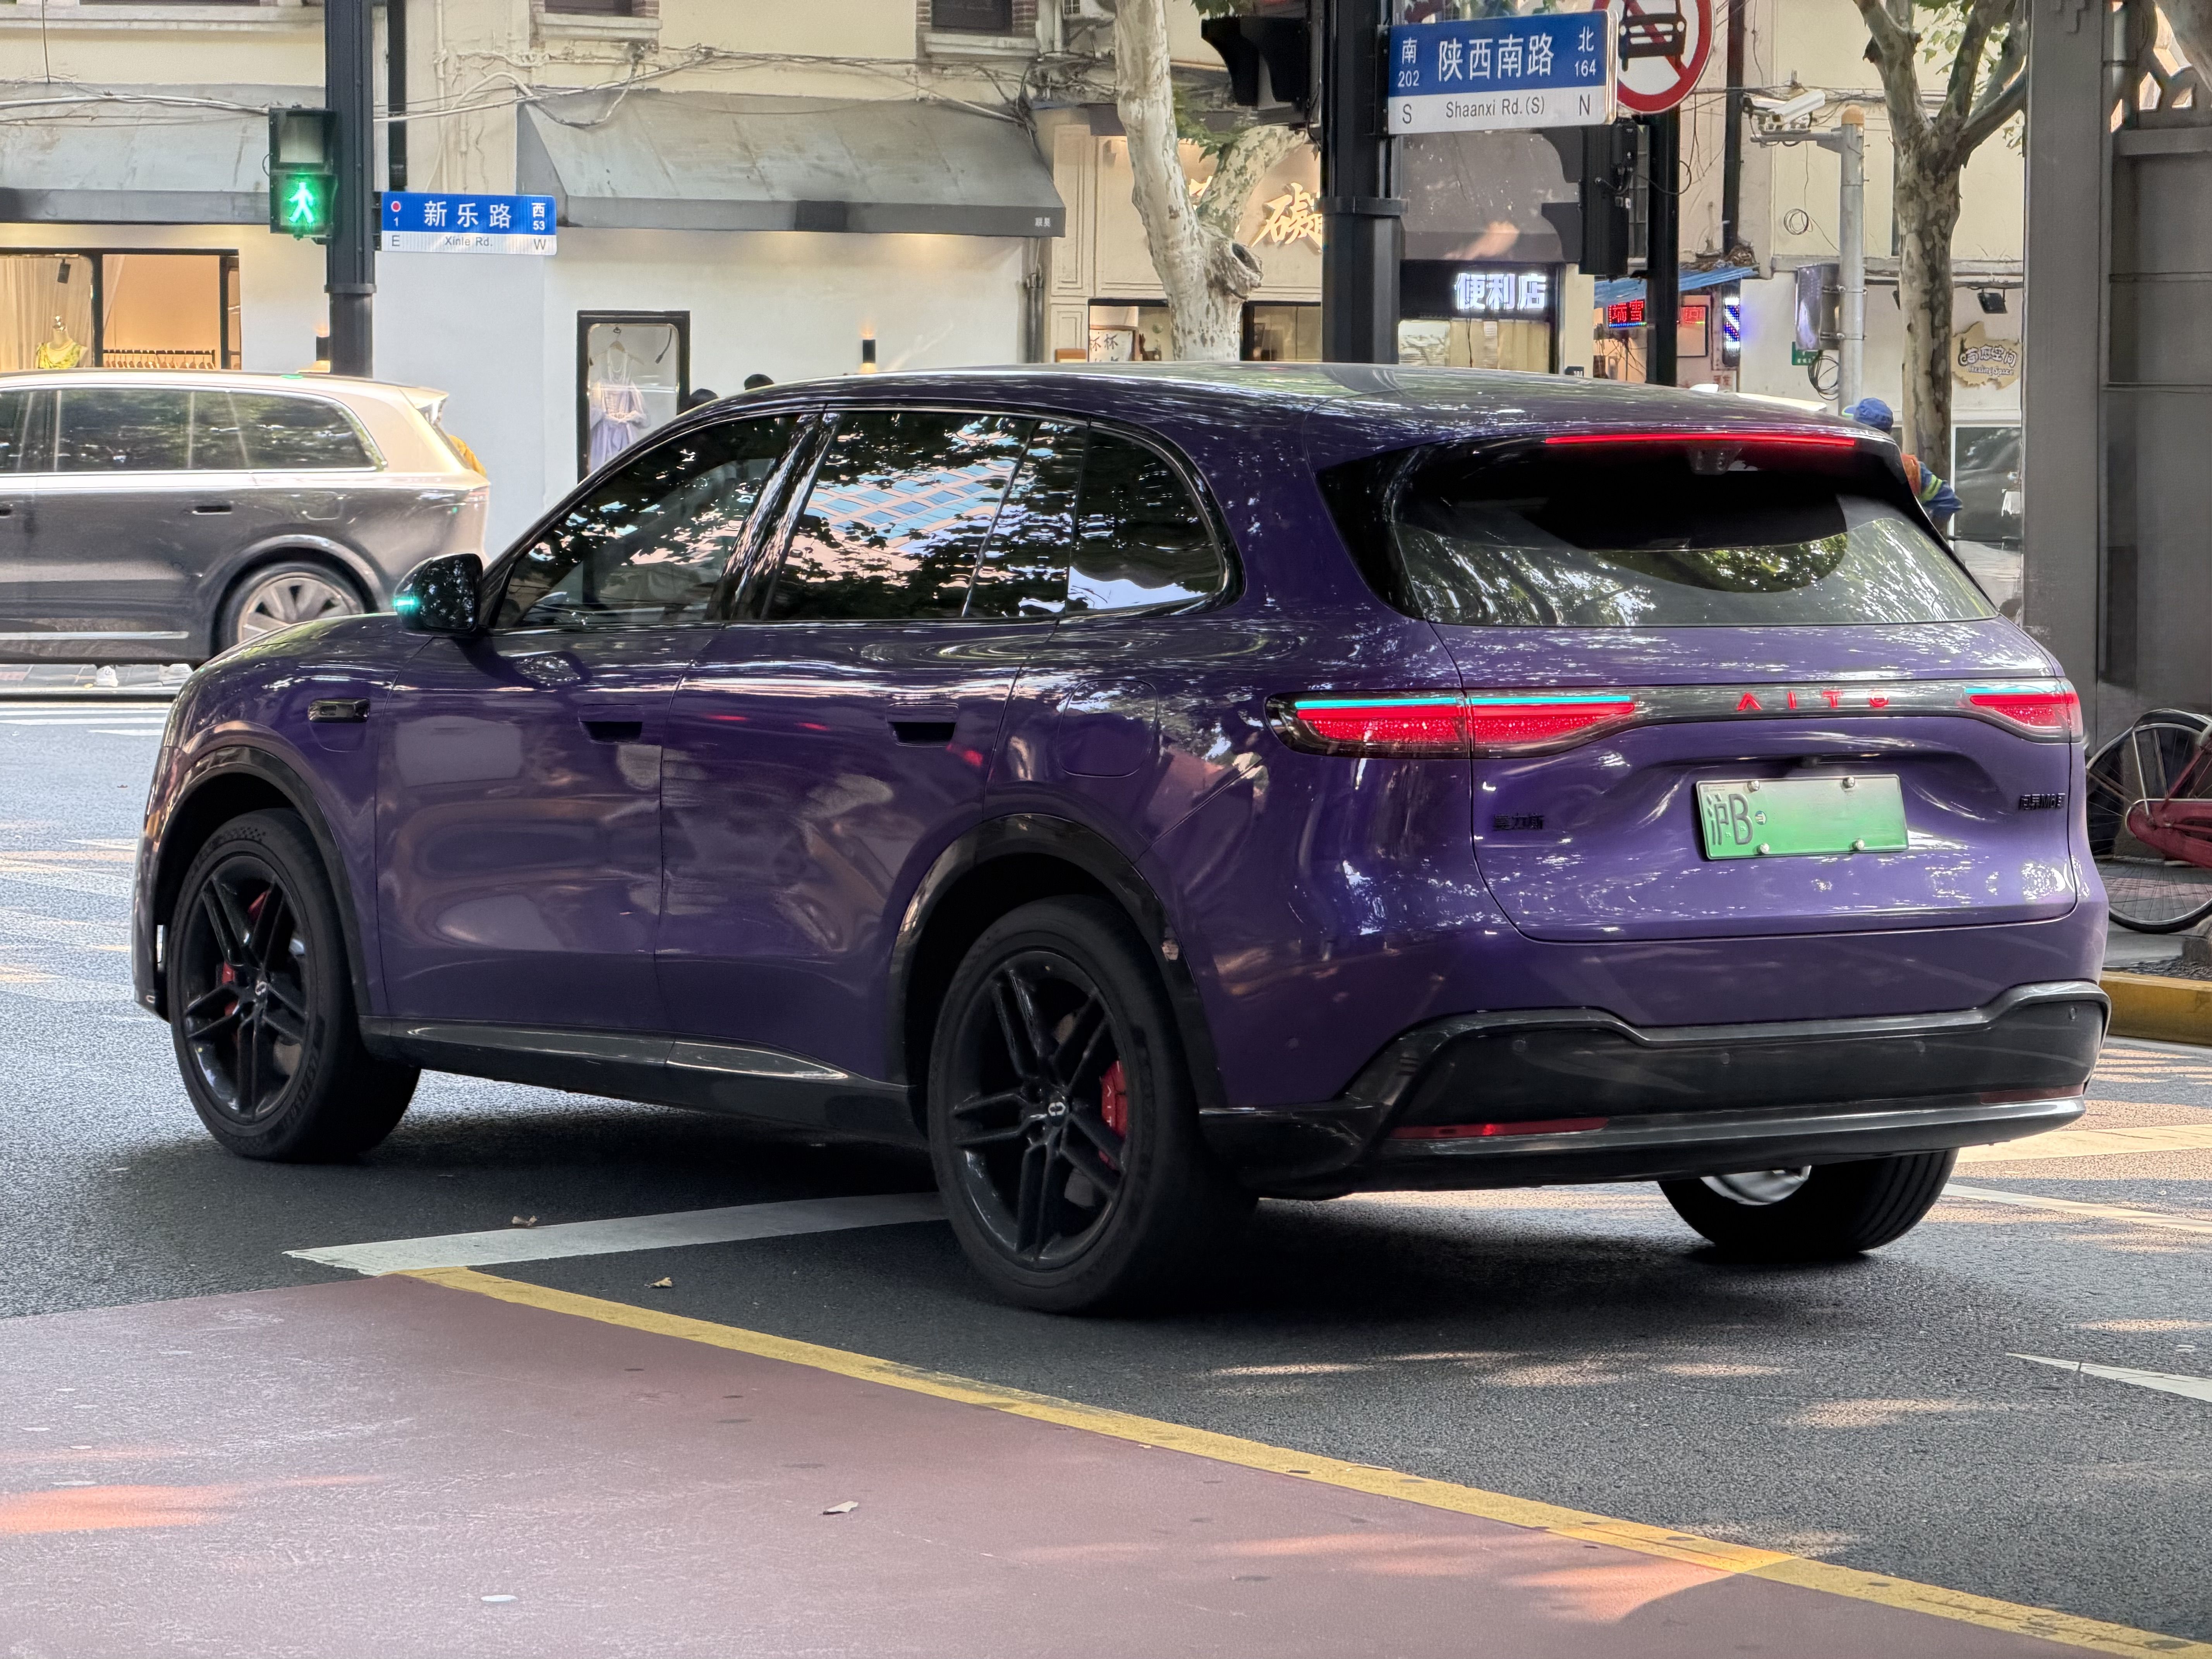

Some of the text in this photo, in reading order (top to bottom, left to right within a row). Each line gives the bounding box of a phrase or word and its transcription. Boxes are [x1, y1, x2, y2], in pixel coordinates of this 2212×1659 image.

[1577, 26, 1595, 52] 北
[1401, 37, 1418, 65] 南
[1438, 32, 1554, 82] 陕西南路
[1574, 60, 1597, 78] 164
[1397, 70, 1420, 88] 202
[1402, 104, 1412, 124] S
[1446, 100, 1496, 118] Shaanxi
[1579, 94, 1590, 116] N
[424, 201, 512, 229] 新乐路
[531, 203, 546, 218] 西
[393, 217, 398, 227] 1
[532, 220, 545, 231] 53
[392, 235, 400, 247] E
[445, 236, 493, 247] Xinle Rd.
[534, 239, 546, 250] W
[1454, 273, 1546, 310] 便利店
[1736, 690, 1889, 711] AITO
